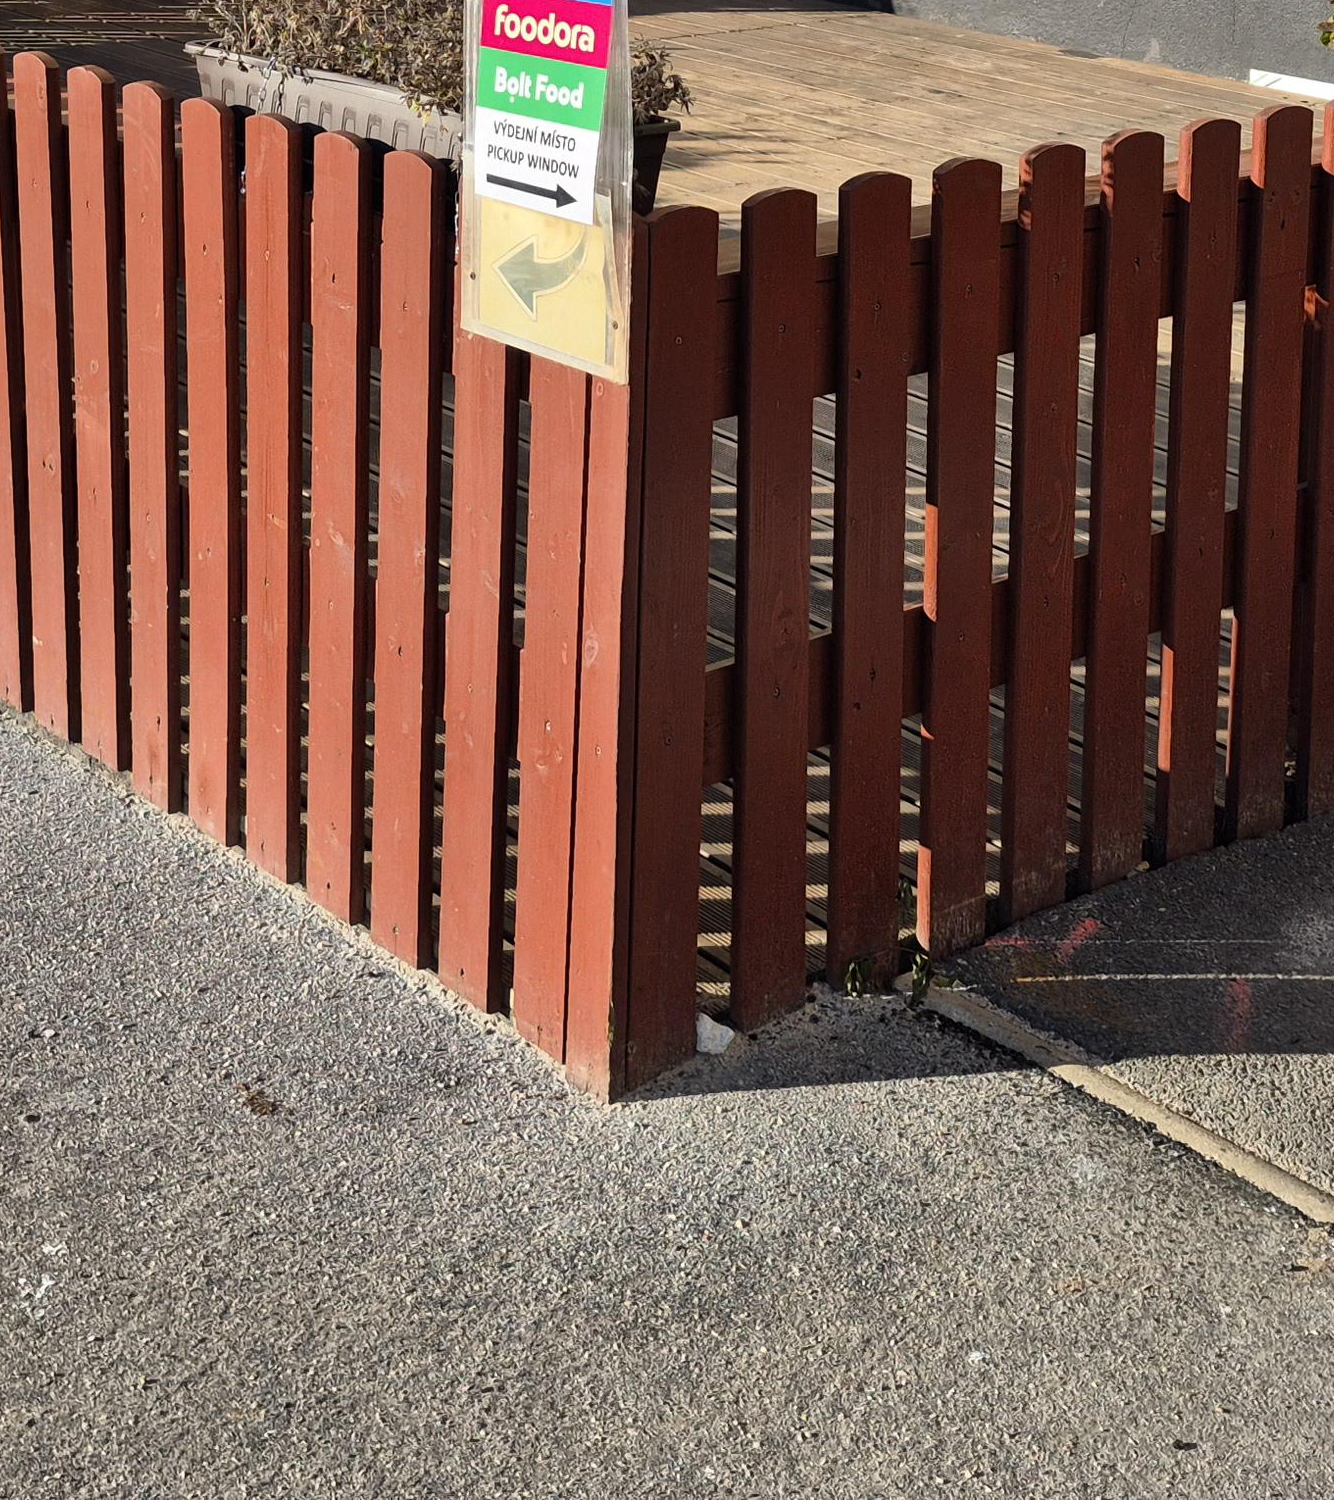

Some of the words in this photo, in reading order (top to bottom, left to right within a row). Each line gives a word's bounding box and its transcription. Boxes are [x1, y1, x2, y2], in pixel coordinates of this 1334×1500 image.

[494, 3, 596, 53] foodora
[494, 65, 532, 104] Bolt
[535, 75, 584, 110] Food
[493, 117, 539, 145] VÝDEJNÍ
[540, 128, 577, 153] MÍSTO
[487, 144, 526, 169] PICKUP
[527, 154, 580, 180] WINDOW
